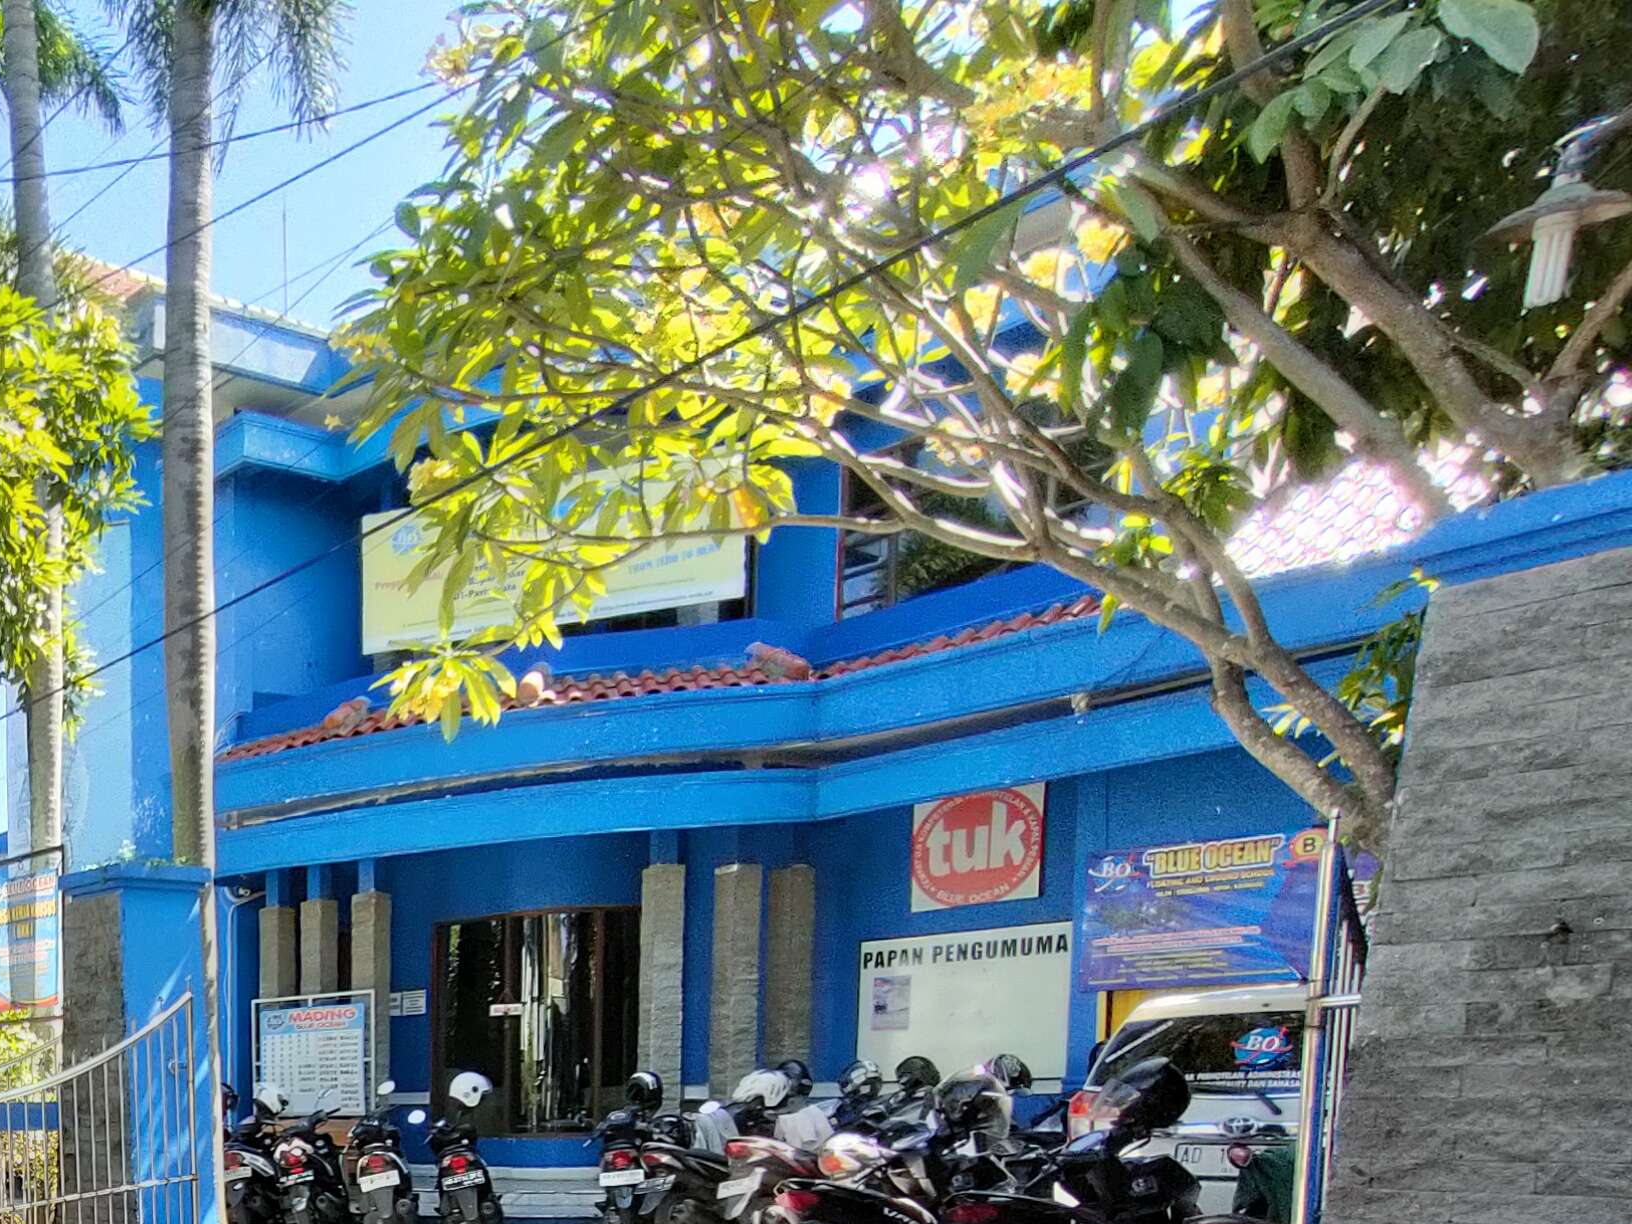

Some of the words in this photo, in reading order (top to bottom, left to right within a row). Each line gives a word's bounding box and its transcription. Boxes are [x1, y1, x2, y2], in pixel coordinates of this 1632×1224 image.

[927, 800, 1026, 877] tuk
[863, 946, 924, 970] PAPAN
[932, 933, 1069, 963] PENGUMUMA
[288, 1007, 356, 1023] MADING
[1246, 1035, 1280, 1051] BO
[1180, 1147, 1202, 1164] AD
